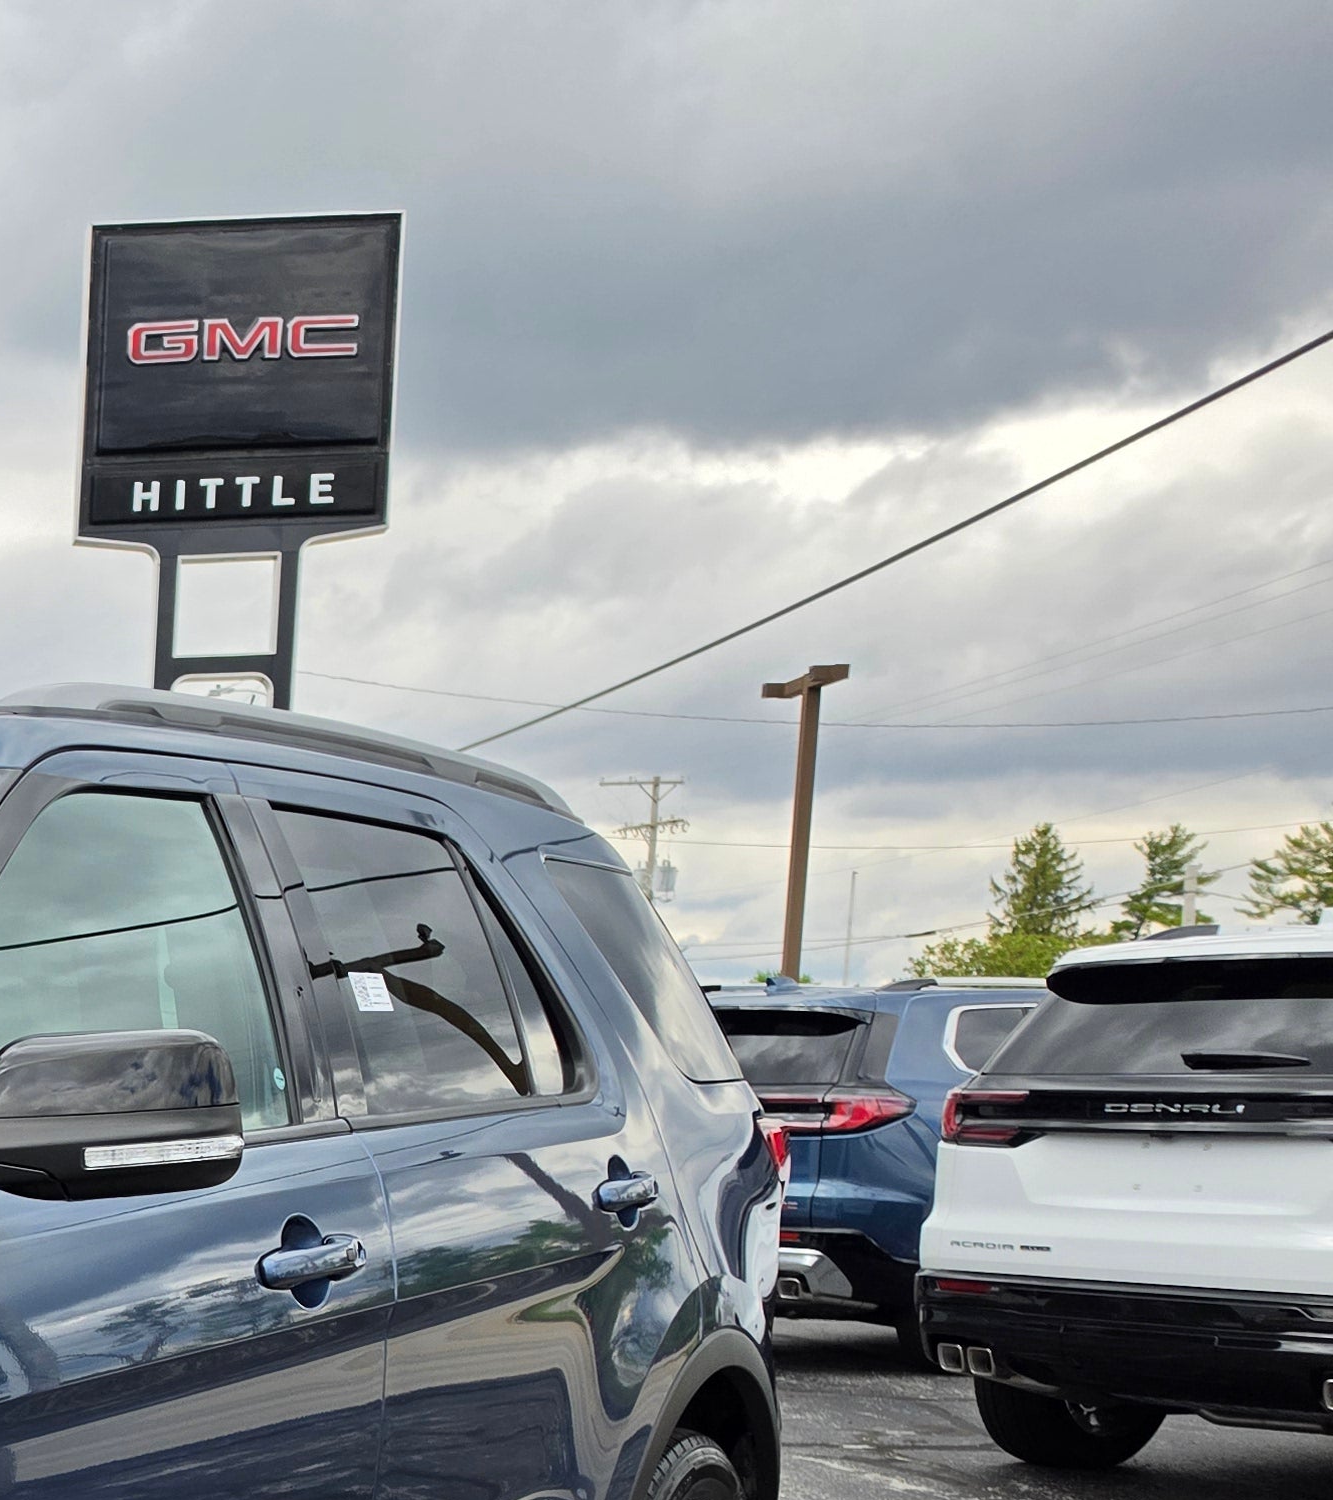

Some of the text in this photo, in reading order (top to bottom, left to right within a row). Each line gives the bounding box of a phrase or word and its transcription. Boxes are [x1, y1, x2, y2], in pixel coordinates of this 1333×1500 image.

[127, 314, 360, 365] GMC
[132, 473, 335, 512] HITTLE
[1103, 1103, 1245, 1114] DENALI
[950, 1240, 1015, 1251] ACADIA
